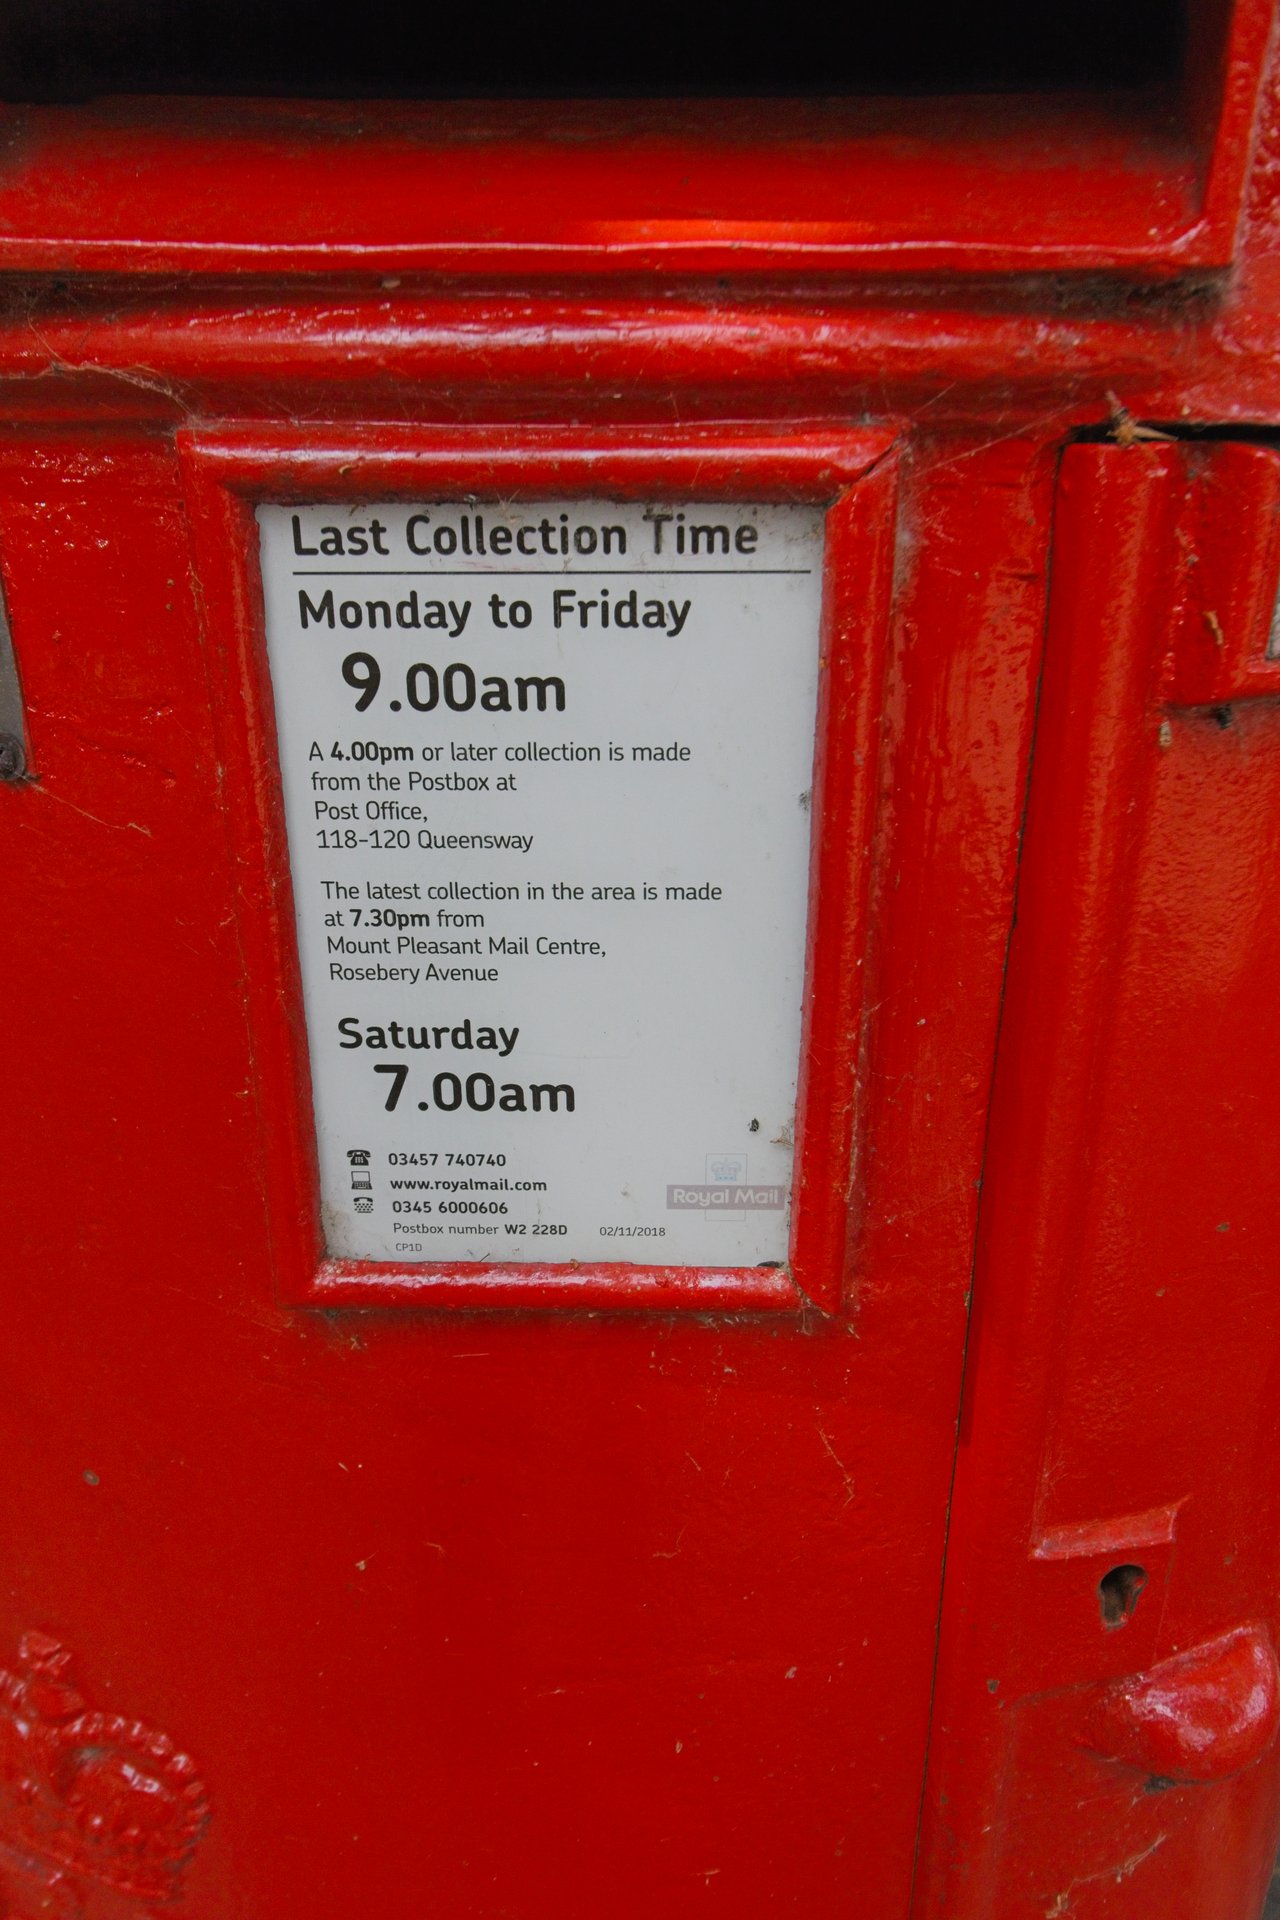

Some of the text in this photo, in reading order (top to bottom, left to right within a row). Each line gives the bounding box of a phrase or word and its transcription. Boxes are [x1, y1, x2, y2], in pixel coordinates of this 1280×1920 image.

[293, 514, 758, 556] Last Collection Time
[298, 589, 691, 638] Monday to Friday
[342, 652, 565, 712] 9.00am
[309, 741, 691, 765] A 4.00pm or later collection is made
[311, 771, 517, 791] from the Postbox at
[315, 801, 427, 823] Post Office,
[316, 830, 533, 853] 118-120 Queensway
[320, 881, 722, 900] The latest collection in the area is made
[325, 909, 484, 931] at 7.30pm from
[327, 936, 606, 957] Mount Pleasant Mail Centre,
[330, 963, 498, 984] Rosebery Avenue
[338, 1017, 519, 1057] Saturday
[373, 1064, 575, 1112] 7.00am
[388, 1153, 506, 1166] 03457 740740
[390, 1178, 547, 1192] www.royalmail.com
[392, 1201, 508, 1214] 0345 6000606
[673, 1189, 779, 1207] Royal Mail
[394, 1223, 567, 1235] Postbox number W2 228D
[600, 1226, 665, 1236] 02/11/2018
